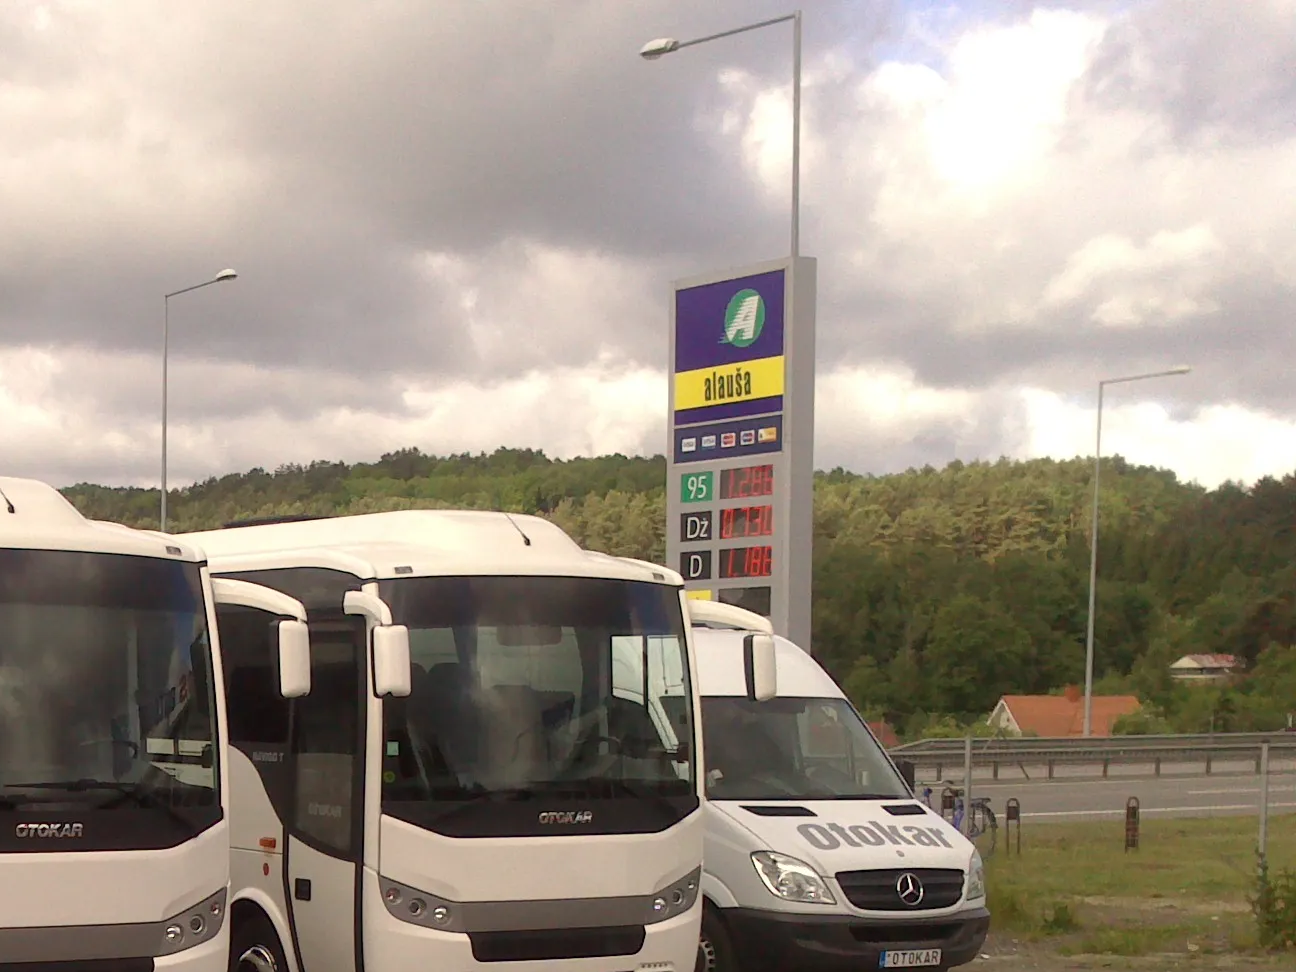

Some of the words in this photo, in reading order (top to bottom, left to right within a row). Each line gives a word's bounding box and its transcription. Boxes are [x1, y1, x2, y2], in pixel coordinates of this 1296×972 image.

[704, 367, 752, 402] alauša
[687, 475, 707, 500] 95
[689, 554, 703, 578] D
[538, 810, 593, 825] OTOKAR
[15, 822, 84, 838] OTOKAR
[796, 820, 953, 851] Otokar
[892, 950, 939, 965] OTOKAR
